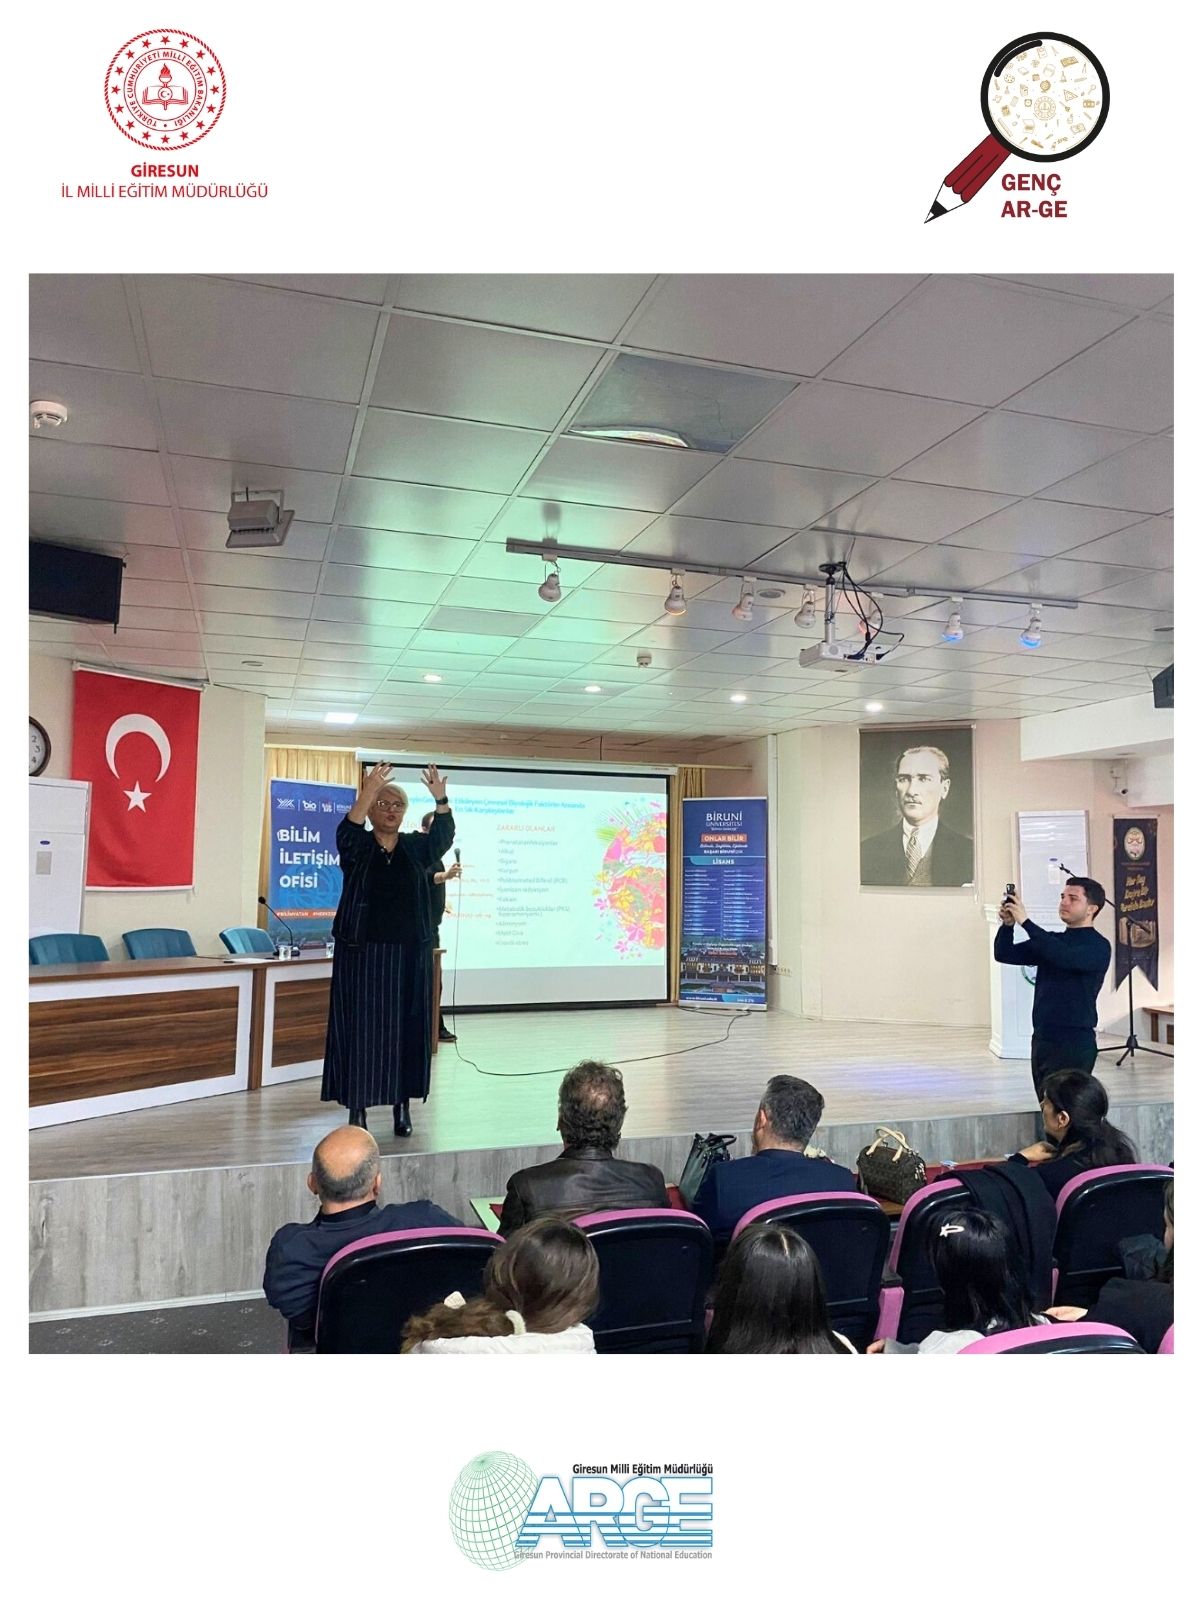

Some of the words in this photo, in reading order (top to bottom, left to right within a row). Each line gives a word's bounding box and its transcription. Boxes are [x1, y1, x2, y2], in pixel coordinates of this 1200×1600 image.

[31, 735, 37, 743] 2
[706, 811, 742, 821] BİRUNİ
[280, 826, 320, 843] BİLİM
[728, 834, 744, 842] BİLİR
[279, 848, 340, 869] İLETİŞİM
[279, 872, 318, 889] OFİSİ
